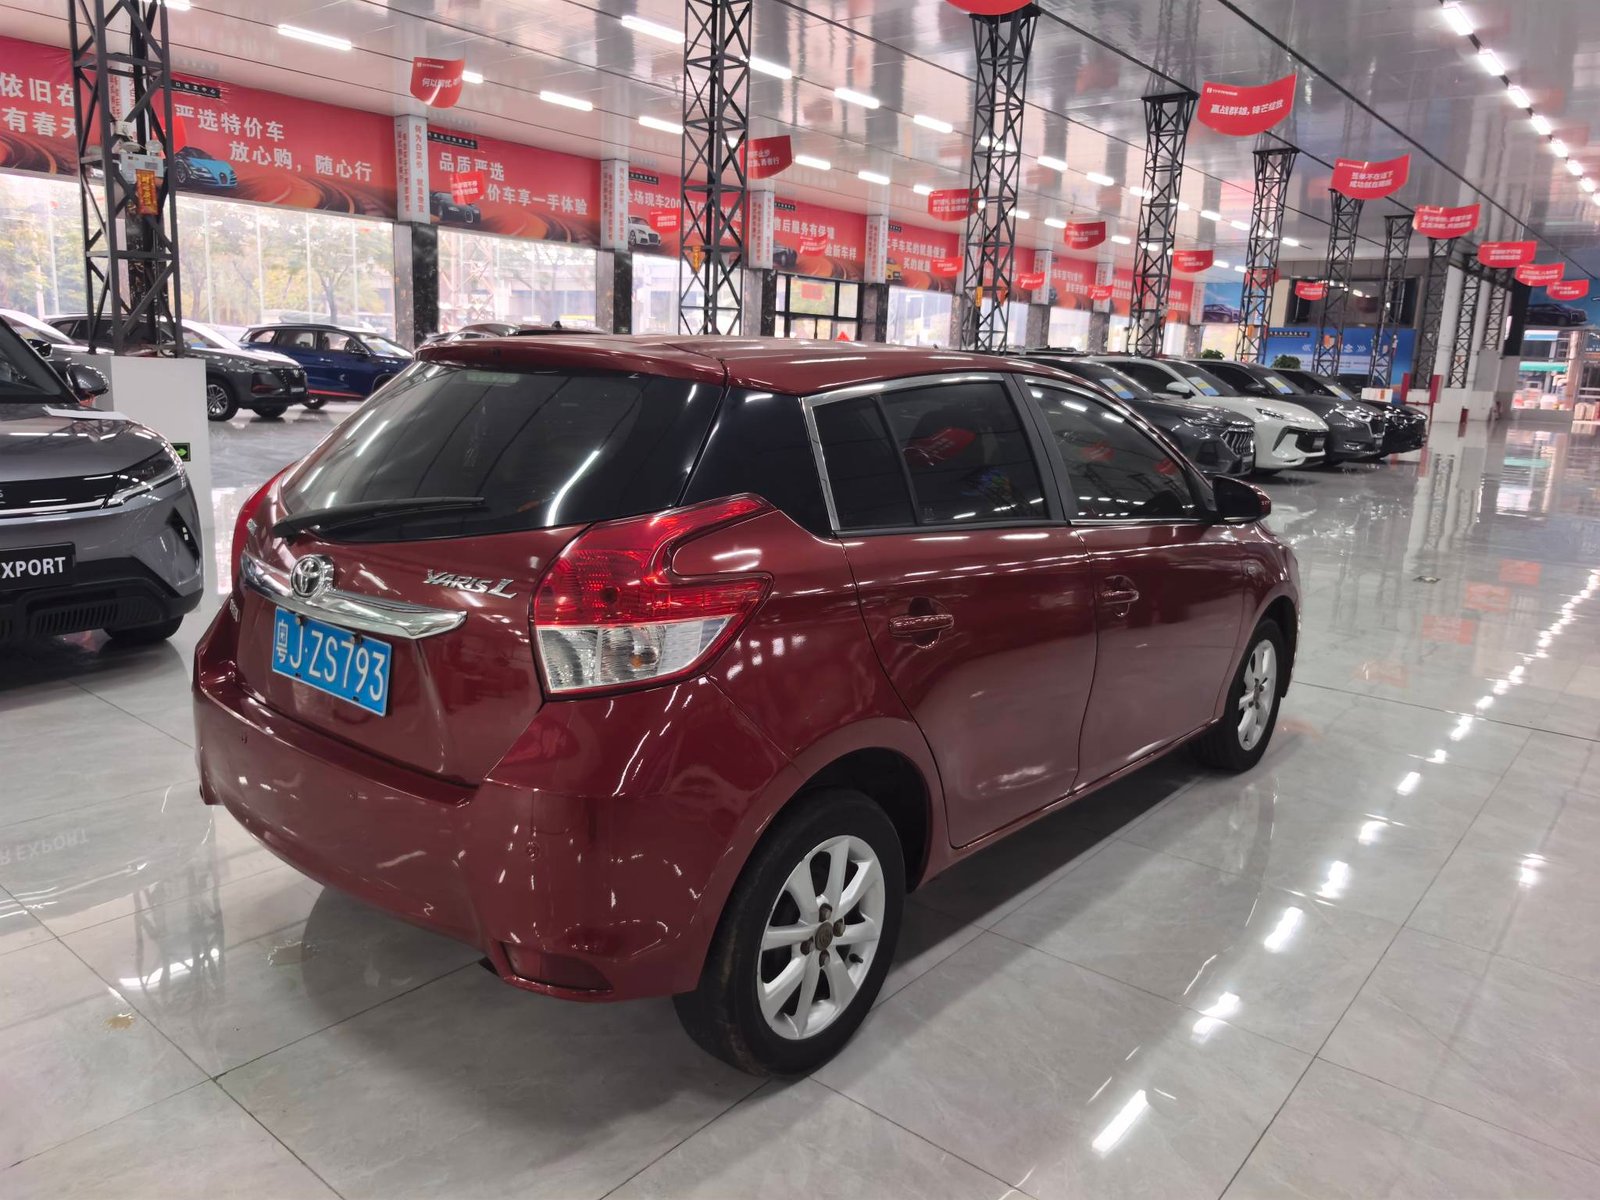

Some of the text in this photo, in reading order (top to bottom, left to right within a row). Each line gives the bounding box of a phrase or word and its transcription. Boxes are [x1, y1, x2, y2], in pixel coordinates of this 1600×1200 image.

[174, 104, 285, 142] 严选特价车
[229, 141, 373, 182] 放心购，随心行
[439, 152, 505, 182] 品质严选
[481, 184, 588, 216] 价车享一手体验
[422, 569, 518, 599] YARIS L
[276, 619, 385, 701] 粤J·ZS793
